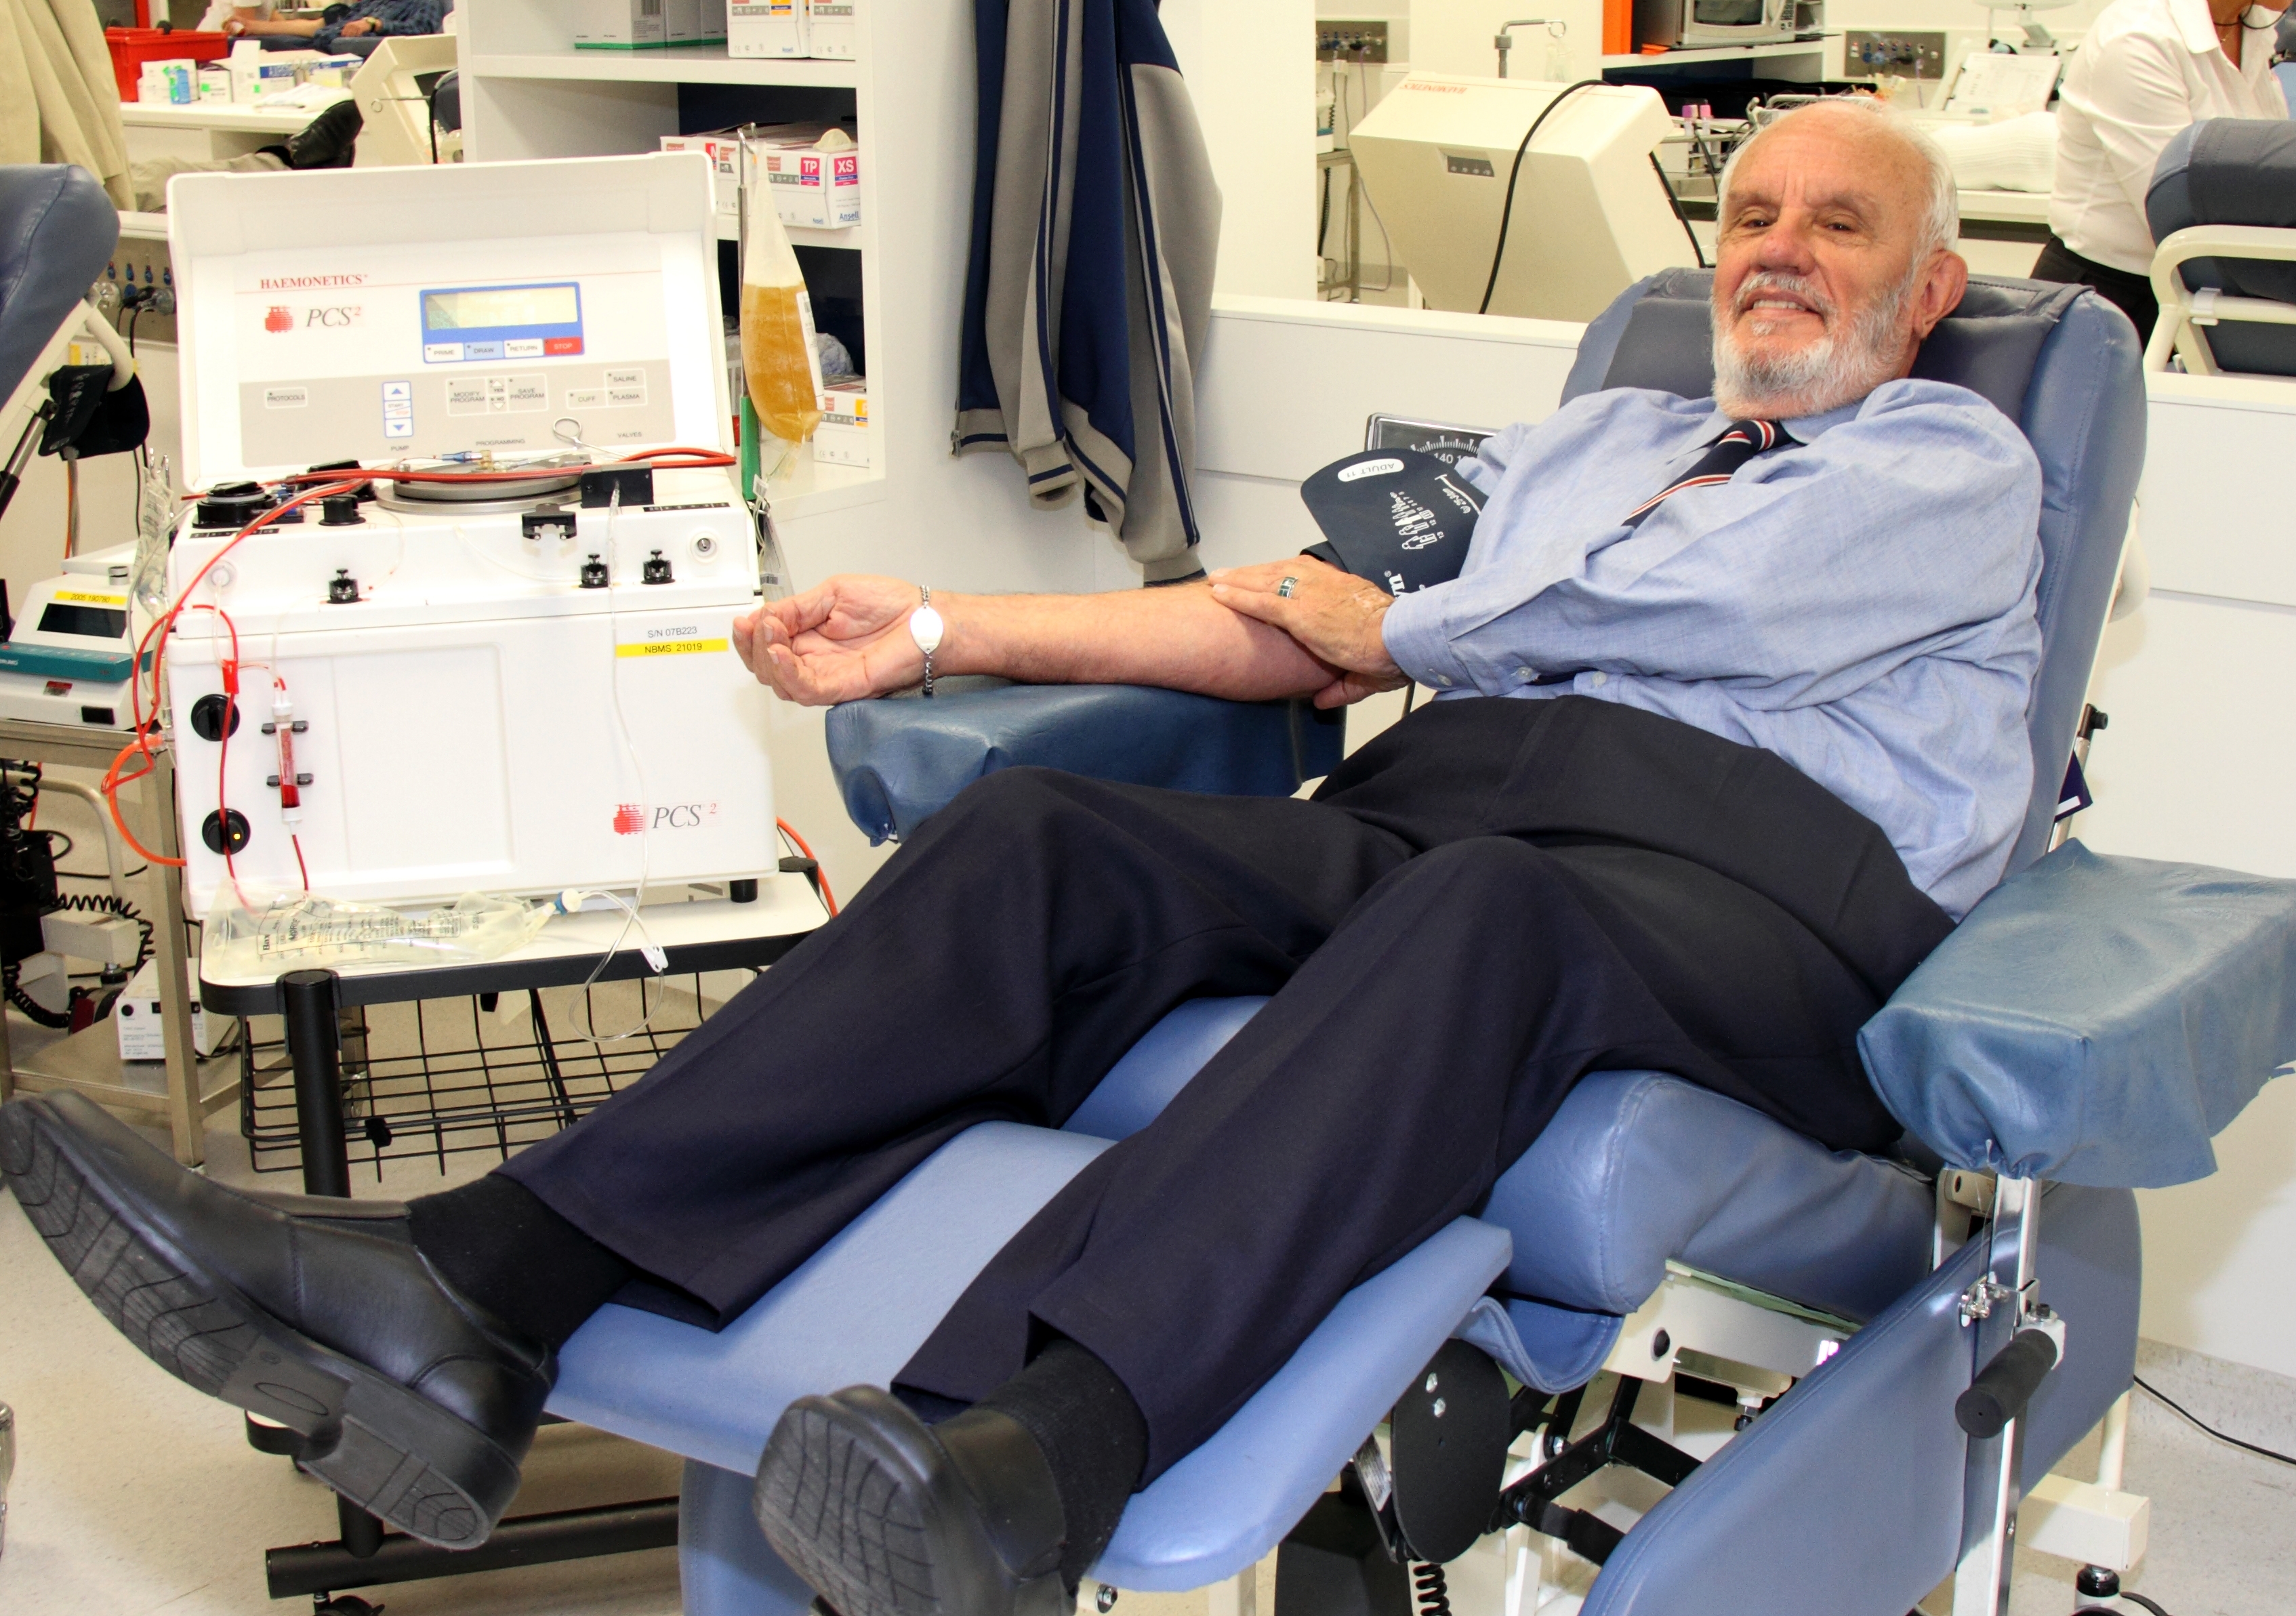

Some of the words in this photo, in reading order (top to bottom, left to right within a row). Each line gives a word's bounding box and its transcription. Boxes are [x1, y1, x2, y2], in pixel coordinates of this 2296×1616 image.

[803, 160, 817, 173] TP
[838, 159, 854, 173] XS
[839, 211, 860, 221] Ansell
[260, 274, 362, 289] HAEMONETICS
[476, 438, 526, 447] PROGRAMMING
[1361, 463, 1395, 474] ADULT
[648, 629, 663, 638] S/N
[665, 626, 697, 636] 07B223
[644, 644, 672, 653] NBMS
[676, 643, 702, 652] 21019
